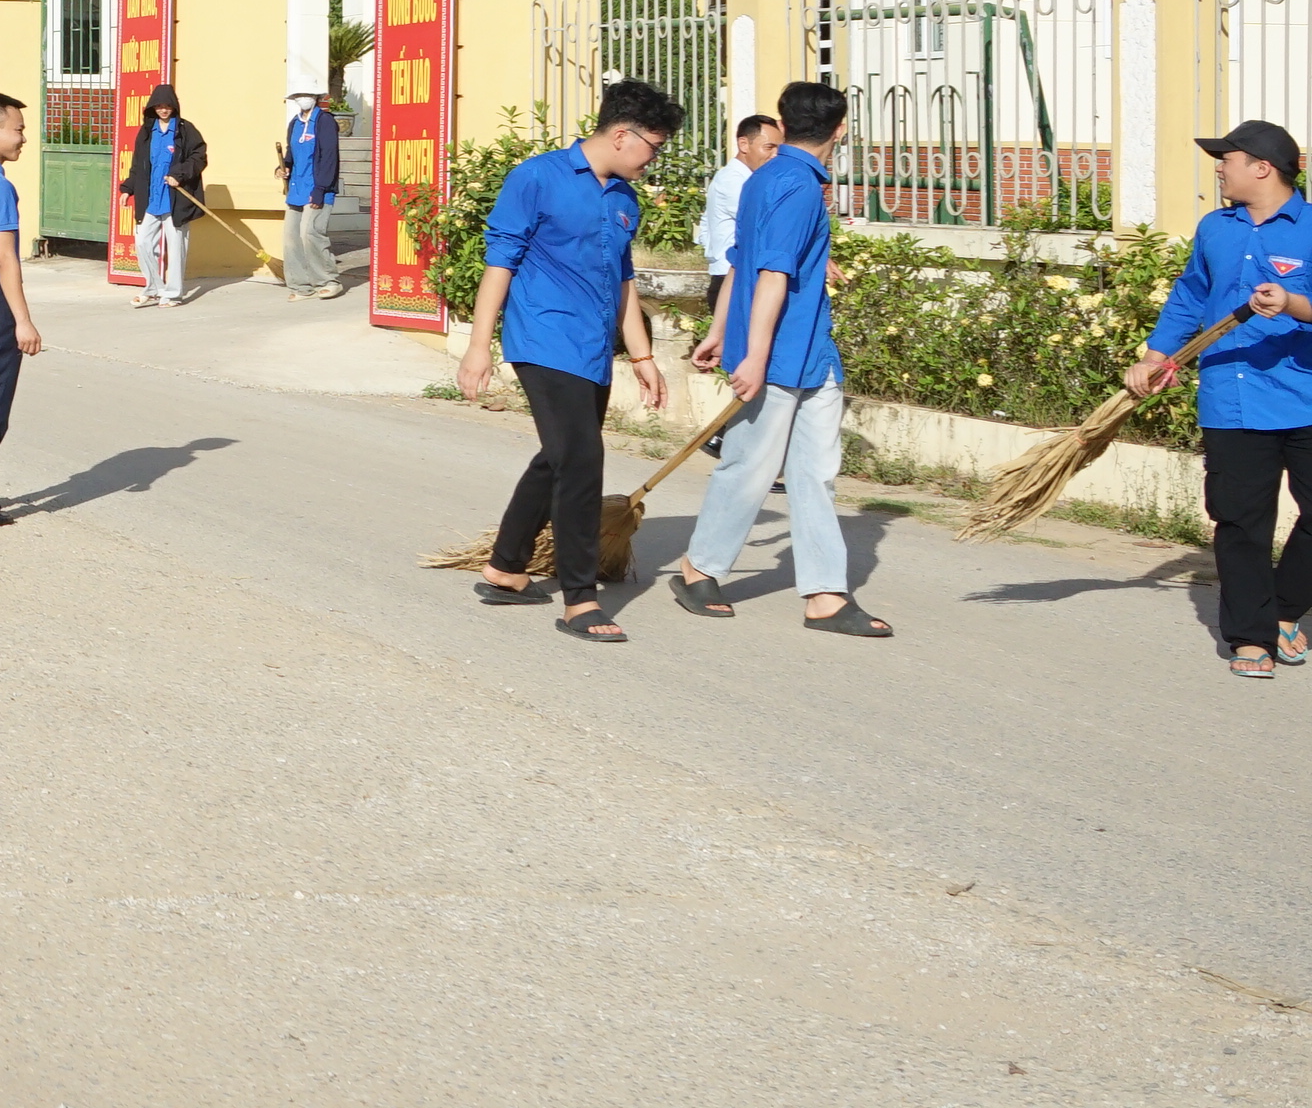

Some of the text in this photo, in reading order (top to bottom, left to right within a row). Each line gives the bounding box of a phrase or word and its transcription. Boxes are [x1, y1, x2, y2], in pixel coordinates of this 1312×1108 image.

[122, 35, 139, 73] NƯỚC
[391, 45, 431, 105] TIẾN VÀO
[125, 89, 140, 127] DÂN
[119, 144, 133, 181] CÔN
[384, 124, 434, 184] KỶ NGUYÊN
